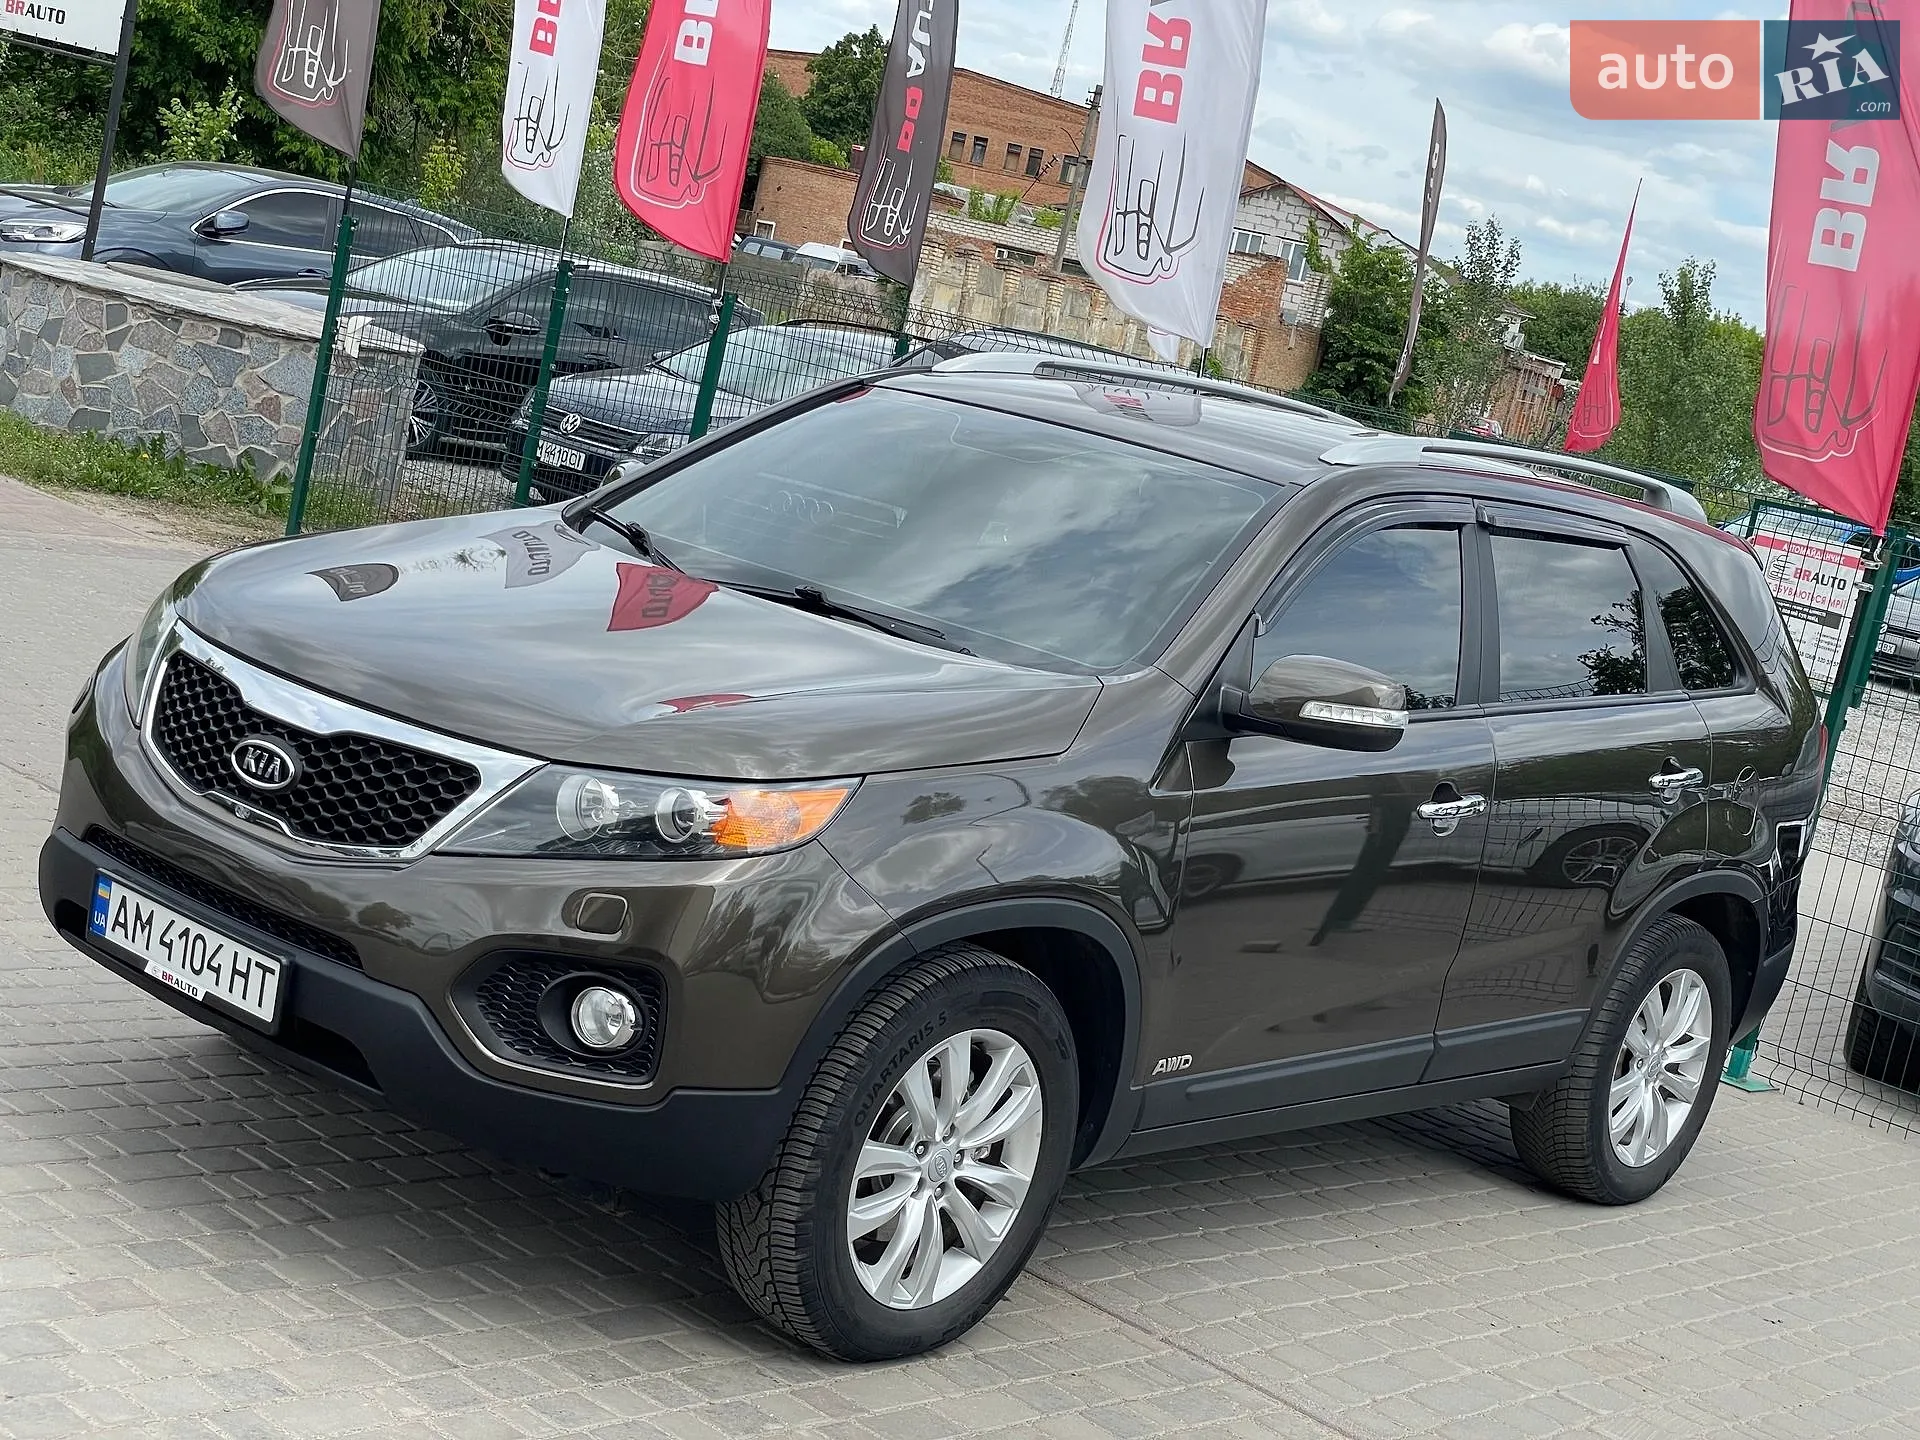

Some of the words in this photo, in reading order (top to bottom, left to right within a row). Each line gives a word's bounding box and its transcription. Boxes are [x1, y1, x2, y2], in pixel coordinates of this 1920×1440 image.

[5, 0, 66, 25] BRAUTO
[1793, 567, 1847, 591] BRAUTO
[243, 746, 281, 782] KIA
[94, 911, 106, 929] UA
[111, 895, 155, 951] AM
[159, 919, 224, 987] 4104
[229, 950, 276, 1008] HT
[161, 970, 198, 997] BRAUTO
[854, 1022, 935, 1127] QUARTARIS
[1151, 1054, 1193, 1076] AWD
